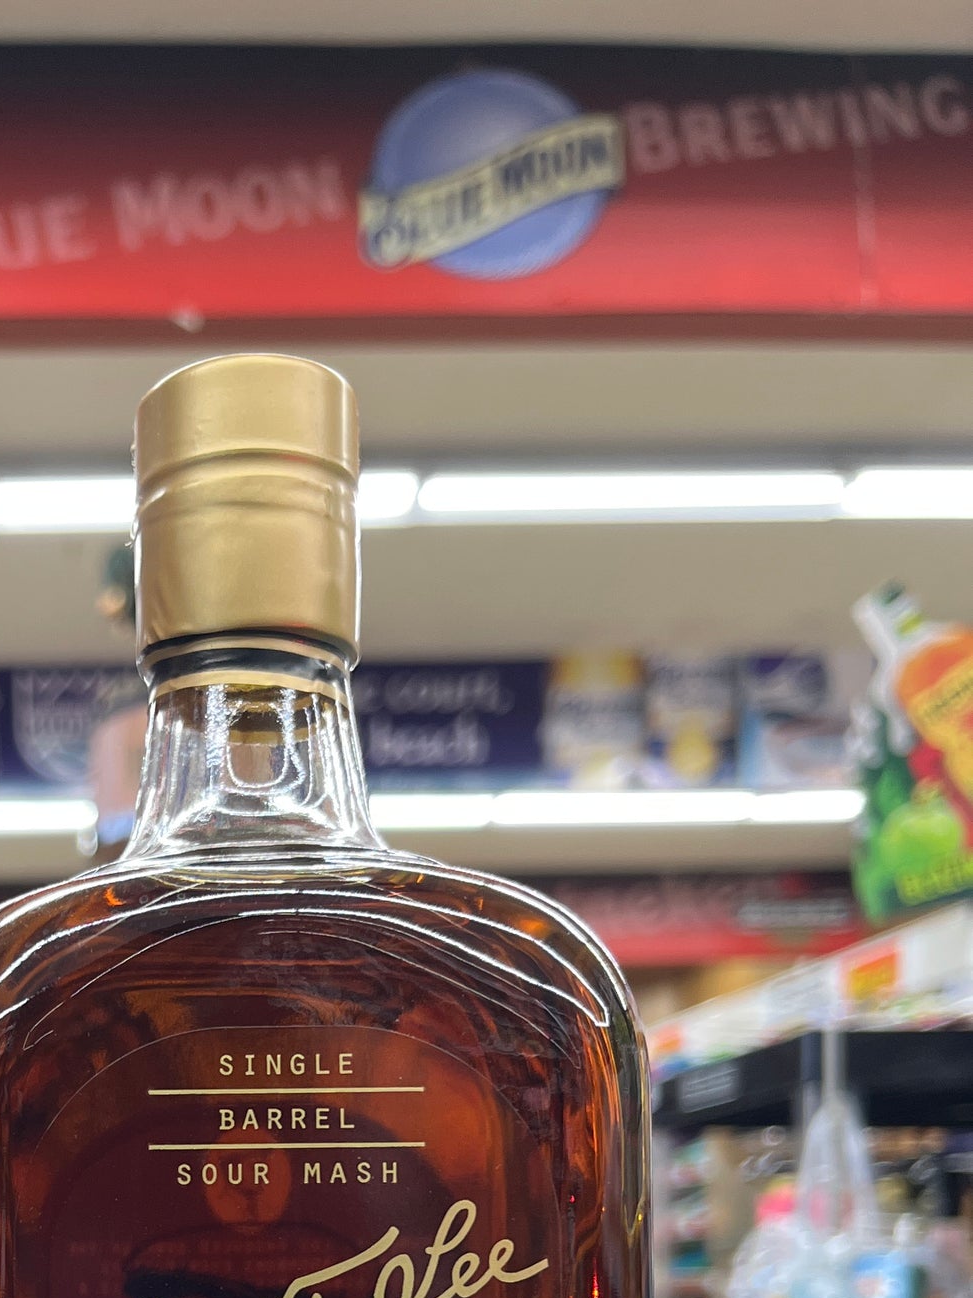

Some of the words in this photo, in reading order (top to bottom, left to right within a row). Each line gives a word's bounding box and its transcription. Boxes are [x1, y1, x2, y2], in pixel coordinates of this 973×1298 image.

[627, 76, 970, 172] BREWING
[111, 158, 345, 252] MOON
[219, 1053, 355, 1076] SINGLE
[219, 1108, 356, 1131] BARREL
[177, 1164, 271, 1186] SOUR
[303, 1162, 399, 1185] MASH
